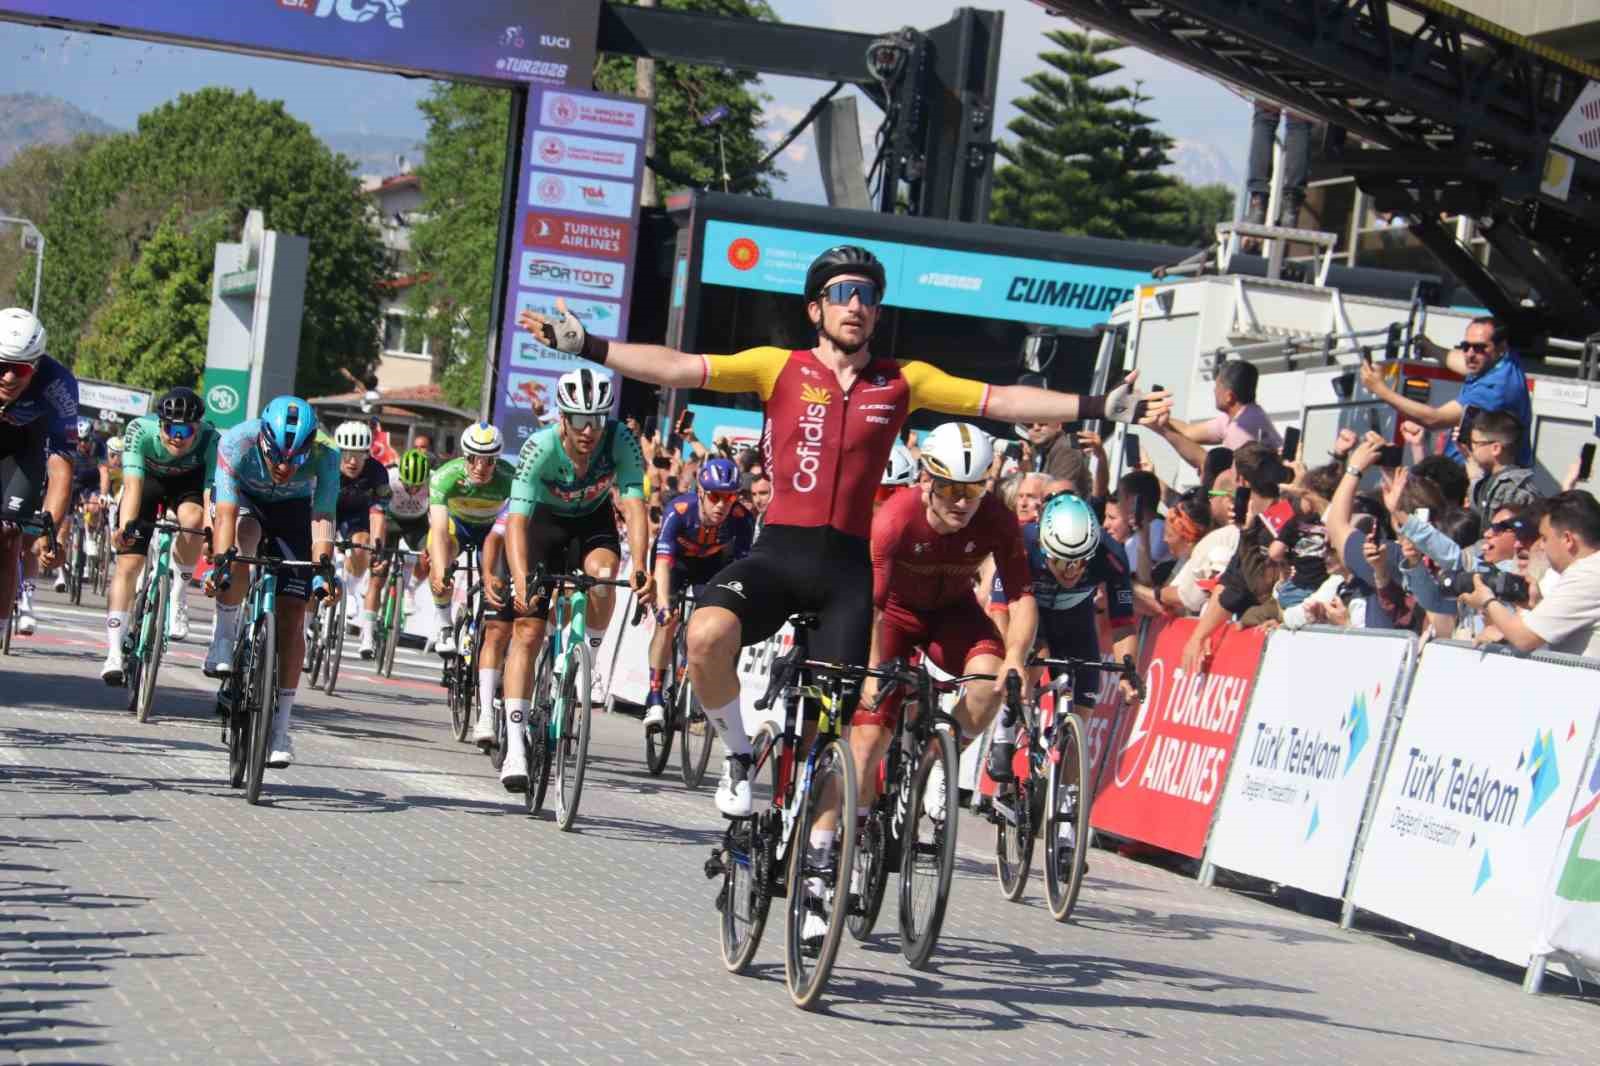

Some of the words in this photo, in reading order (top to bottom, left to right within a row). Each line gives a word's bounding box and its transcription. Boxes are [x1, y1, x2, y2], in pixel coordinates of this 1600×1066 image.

[560, 234, 620, 252] AIRLINES
[562, 221, 621, 241] TURKISH
[792, 403, 826, 493] Cofidis
[1163, 667, 1248, 734] TURKISH
[1140, 735, 1227, 805] AIRLINES
[1249, 722, 1286, 770] Türk
[1284, 728, 1342, 780] Telekom
[1401, 747, 1444, 804] Türk
[1443, 758, 1519, 826] Telekom
